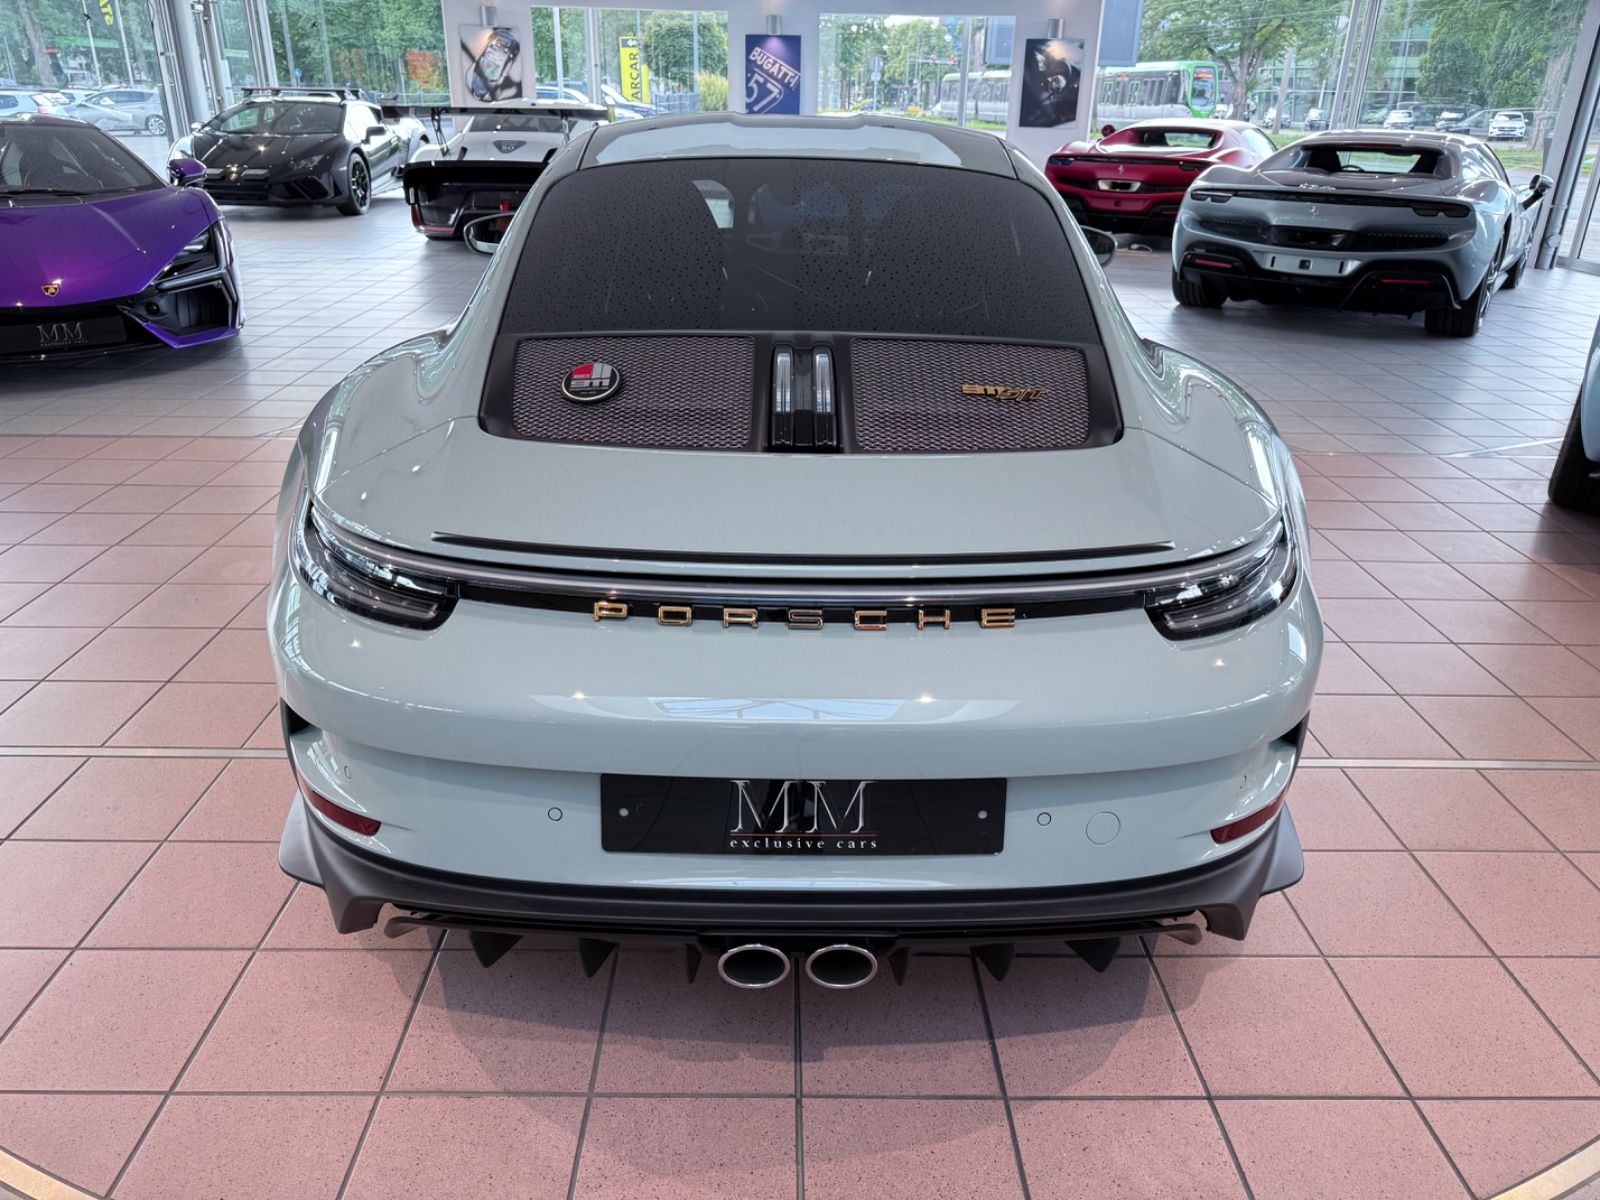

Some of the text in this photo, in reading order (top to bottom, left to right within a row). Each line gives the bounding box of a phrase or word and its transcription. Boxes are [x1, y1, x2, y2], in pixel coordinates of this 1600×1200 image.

[629, 52, 641, 101] ARCAR
[749, 47, 799, 88] BUGATTI
[745, 73, 780, 112] 57
[36, 322, 82, 342] MM
[593, 601, 1017, 630] PORSCHE
[730, 780, 876, 834] MM
[729, 837, 877, 849] exclusive cars
